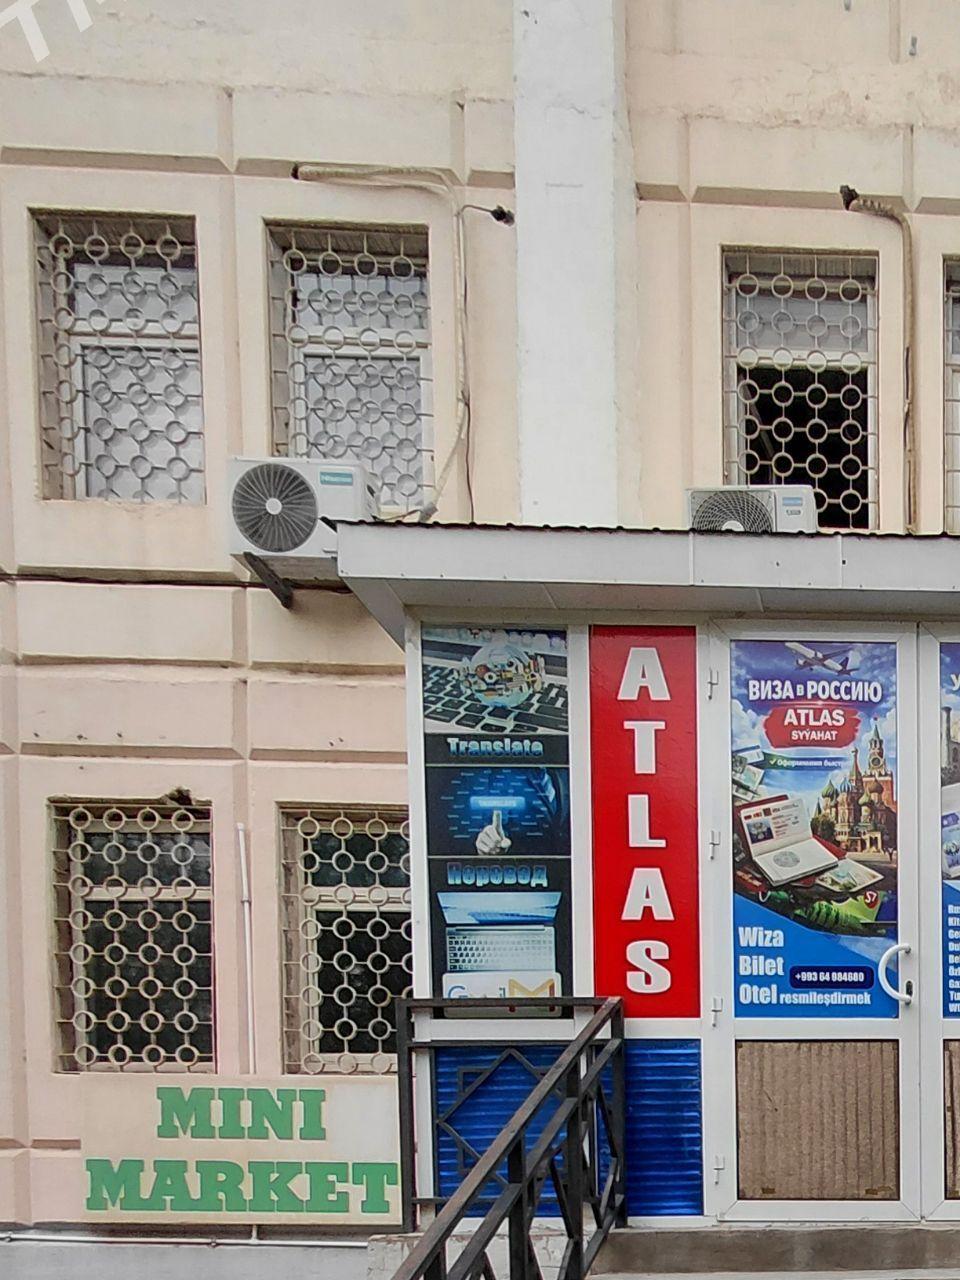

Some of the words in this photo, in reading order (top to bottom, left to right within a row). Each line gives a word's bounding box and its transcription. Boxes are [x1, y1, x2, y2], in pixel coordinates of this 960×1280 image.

[748, 679, 794, 701] ВИЗА
[807, 680, 882, 703] РОССИЮ
[784, 709, 845, 726] ATLAS
[447, 737, 544, 757] Translate
[617, 647, 674, 994] ATLAS
[738, 926, 785, 947] Wiza
[738, 955, 784, 976] Bilet
[739, 984, 777, 1005] Otel
[780, 991, 871, 1006] resmileşdirmek
[157, 1087, 326, 1140] MINI
[86, 1159, 398, 1213] MARKET
